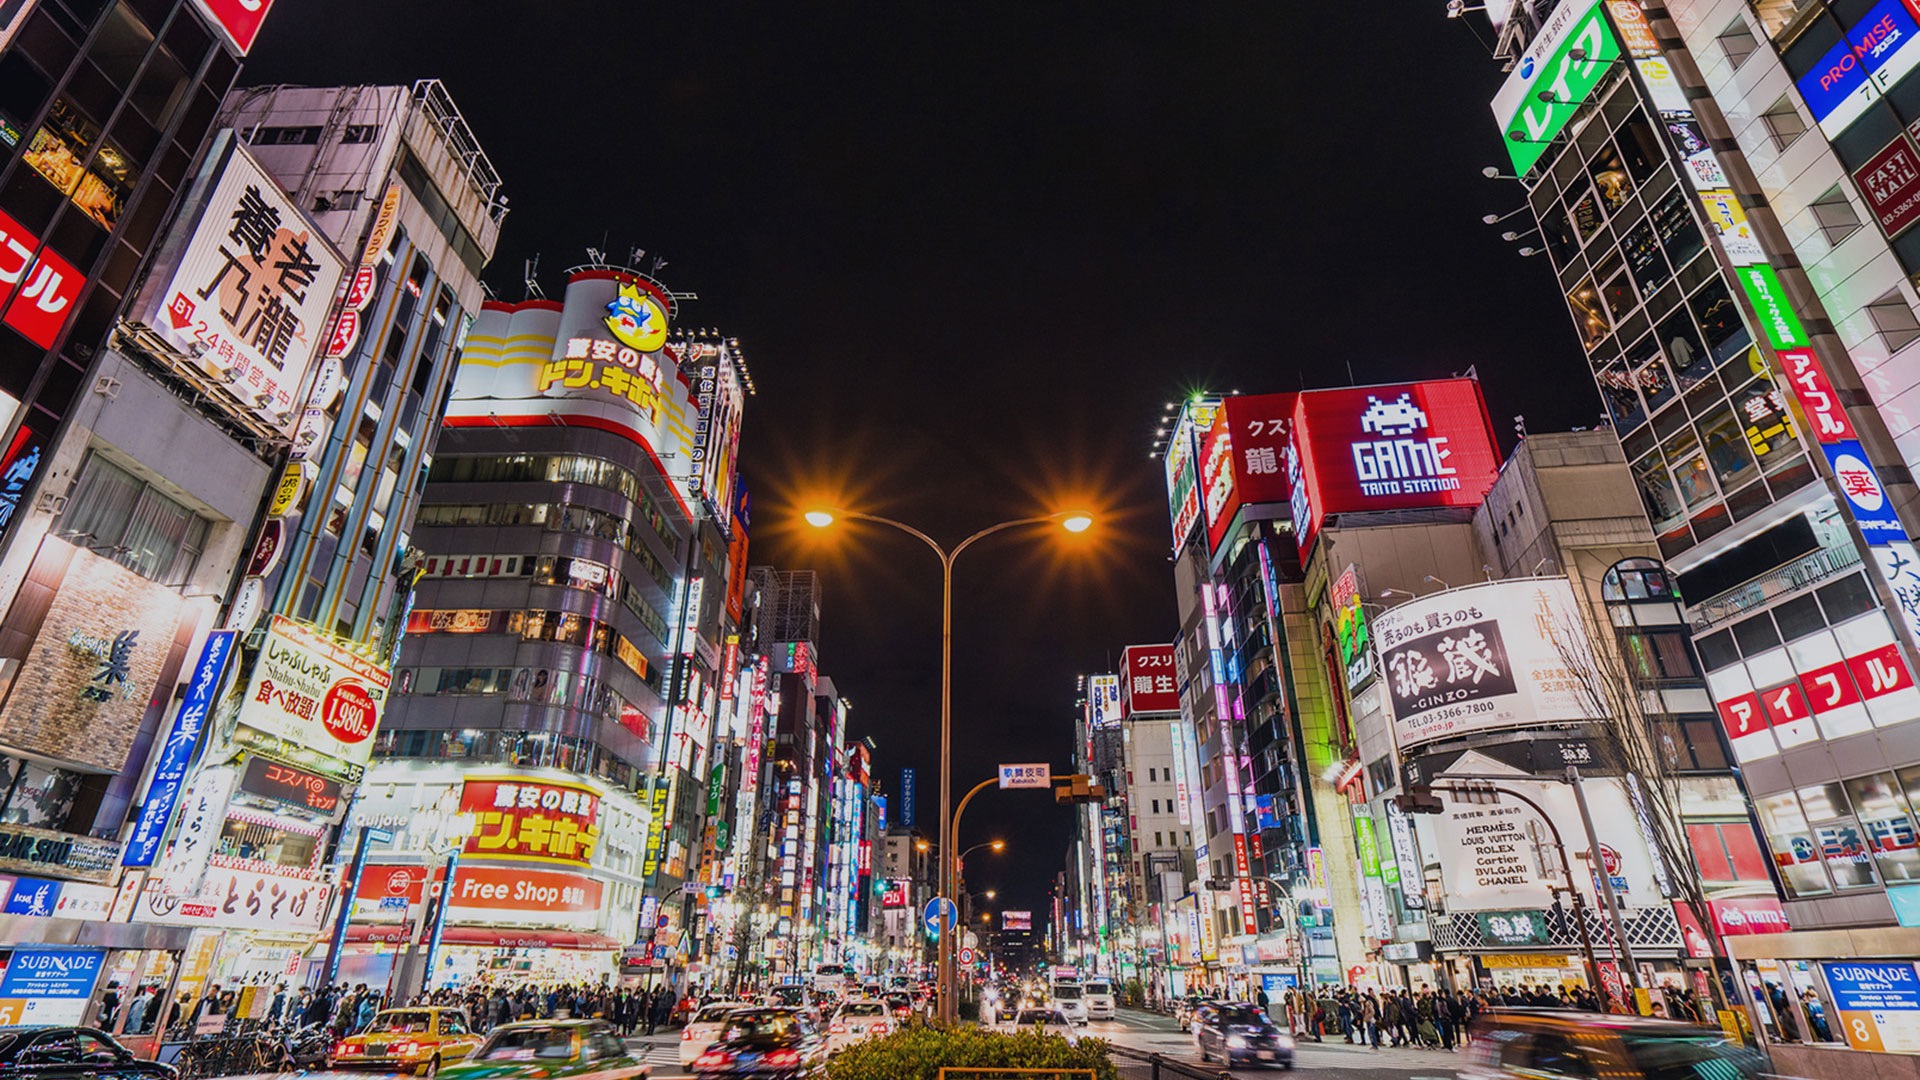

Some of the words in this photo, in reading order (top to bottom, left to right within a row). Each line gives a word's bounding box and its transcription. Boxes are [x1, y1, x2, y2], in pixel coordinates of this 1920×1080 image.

[1535, 5, 1572, 59] 新生銀行
[1871, 30, 1902, 58] プロミス
[1820, 14, 1897, 91] PROMISE
[1523, 16, 1602, 142] レイク
[1866, 153, 1906, 188] FAST
[1875, 170, 1916, 203] NAIL
[173, 297, 193, 322] B1
[193, 320, 291, 407] 24時間営業中
[1786, 353, 1845, 435] アイフル
[1351, 437, 1457, 480] GAME
[1360, 481, 1400, 496] TAITO
[1404, 477, 1460, 494] STATION
[1839, 470, 1879, 497] 薬
[268, 639, 329, 684] しゃぶしゃぶ
[1137, 655, 1173, 668] クスリ
[1730, 658, 1899, 733] アイフル
[326, 697, 363, 735] 1,980
[155, 782, 177, 824] ワインと
[355, 813, 408, 829] Quijote
[1461, 836, 1485, 847] LOUIS
[1488, 832, 1526, 843] VUITTON
[1475, 845, 1516, 856] ROLEX
[1475, 865, 1528, 876] BVLGARI
[1476, 855, 1519, 866] Cartier
[462, 878, 508, 899] Free
[513, 880, 558, 906] Shop
[1478, 876, 1528, 887] CHANEL
[222, 875, 315, 920] とらそば
[500, 938, 516, 946] Don
[518, 938, 547, 947] Quijote
[17, 954, 95, 972] SUBNADE
[1831, 966, 1912, 984] SUBNADE
[0, 1006, 14, 1026] 5
[1852, 1018, 1870, 1043] 8
